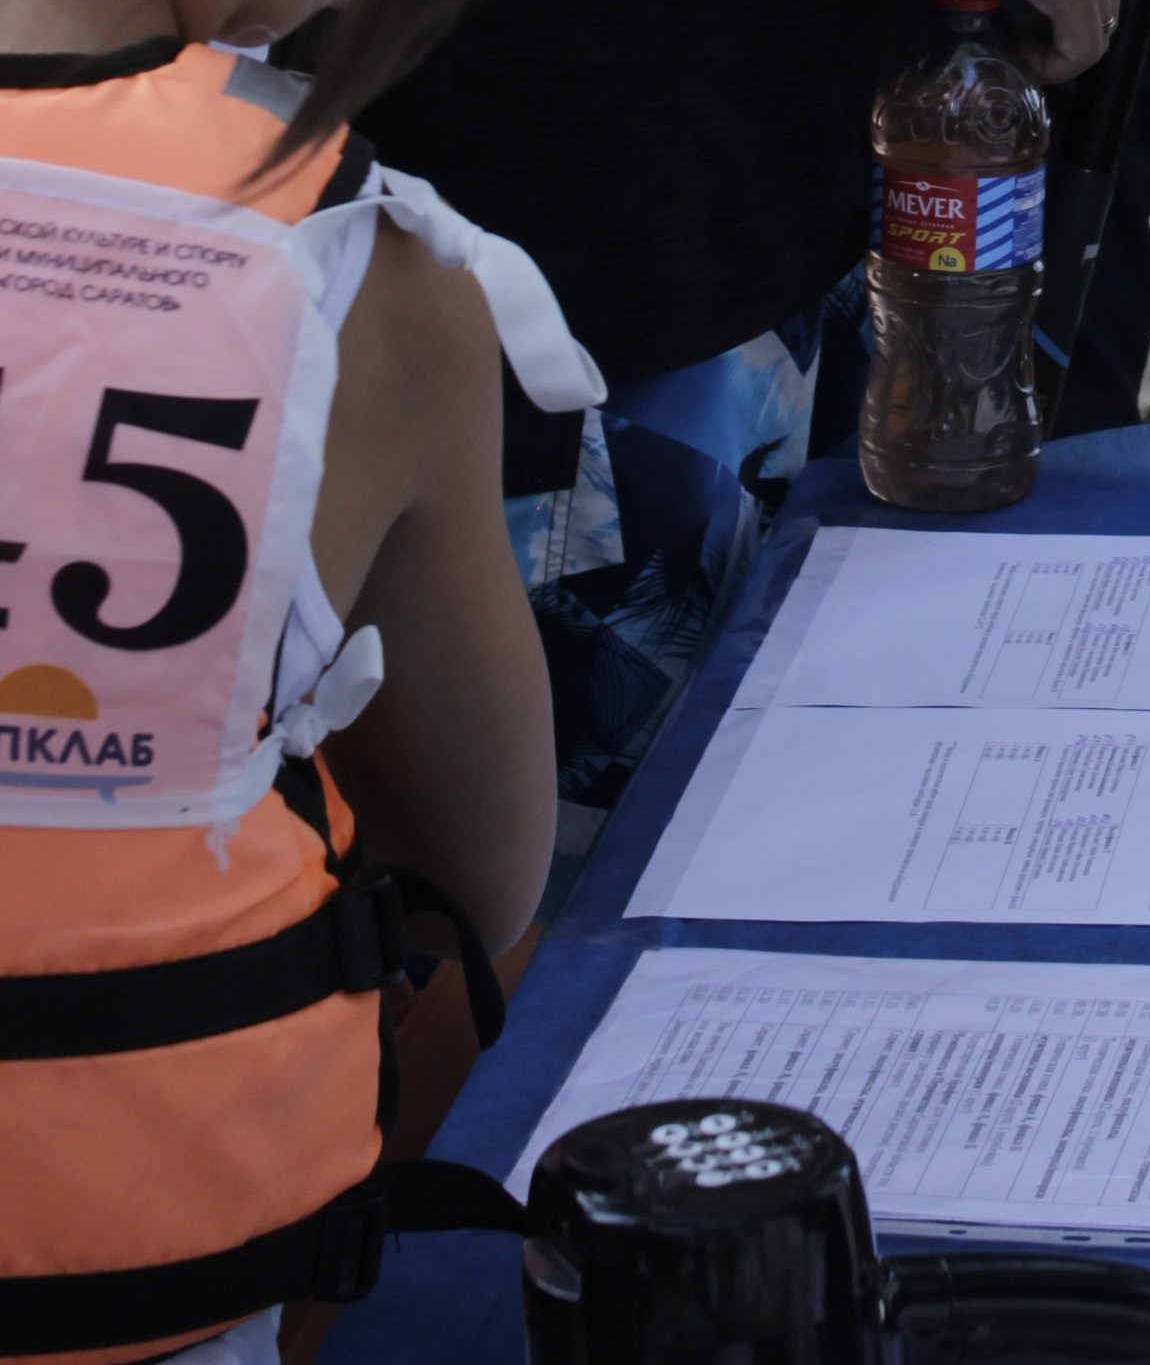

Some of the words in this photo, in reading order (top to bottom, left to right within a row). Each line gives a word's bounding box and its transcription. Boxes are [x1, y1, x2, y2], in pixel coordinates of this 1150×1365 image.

[887, 188, 966, 219] MEVER
[887, 222, 967, 245] SPORT
[155, 242, 170, 255] И
[937, 254, 957, 267] Na
[0, 368, 260, 651] 5
[0, 724, 155, 767] ПКЛАБ
